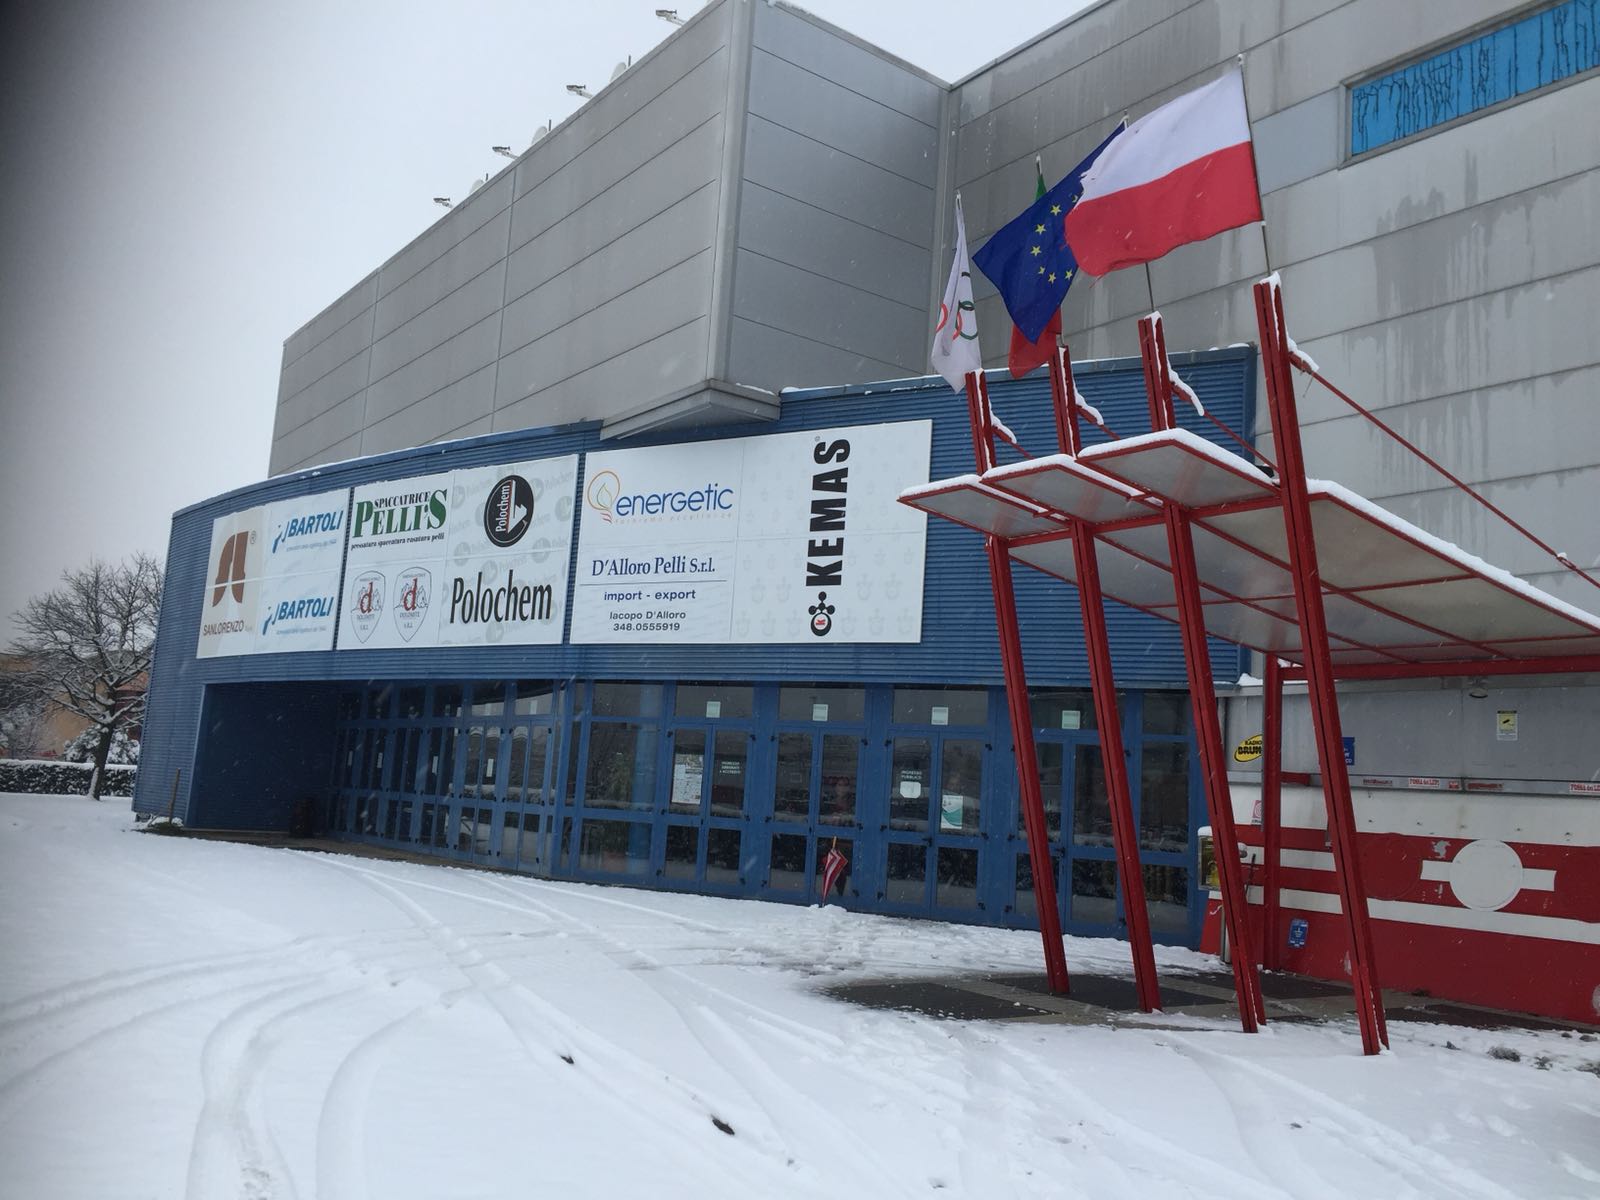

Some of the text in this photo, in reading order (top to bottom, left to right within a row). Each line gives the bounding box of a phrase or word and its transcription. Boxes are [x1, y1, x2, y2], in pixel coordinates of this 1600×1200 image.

[374, 491, 430, 509] SPACCATRICE
[495, 485, 511, 533] Polochem
[615, 483, 734, 516] energetic
[805, 439, 851, 587] KEMAS
[287, 510, 344, 538] BARTOLI
[431, 532, 445, 542] pelli
[591, 555, 715, 576] D'Alloro Pelli S.r.l.
[449, 569, 552, 624] Polochem
[603, 590, 643, 602] import
[654, 589, 696, 602] export
[278, 596, 335, 621] BARTOLI
[609, 611, 687, 621] Iacopo D'Alloro
[203, 620, 245, 636] SANLORENZO
[613, 622, 681, 632] 348.0555919
